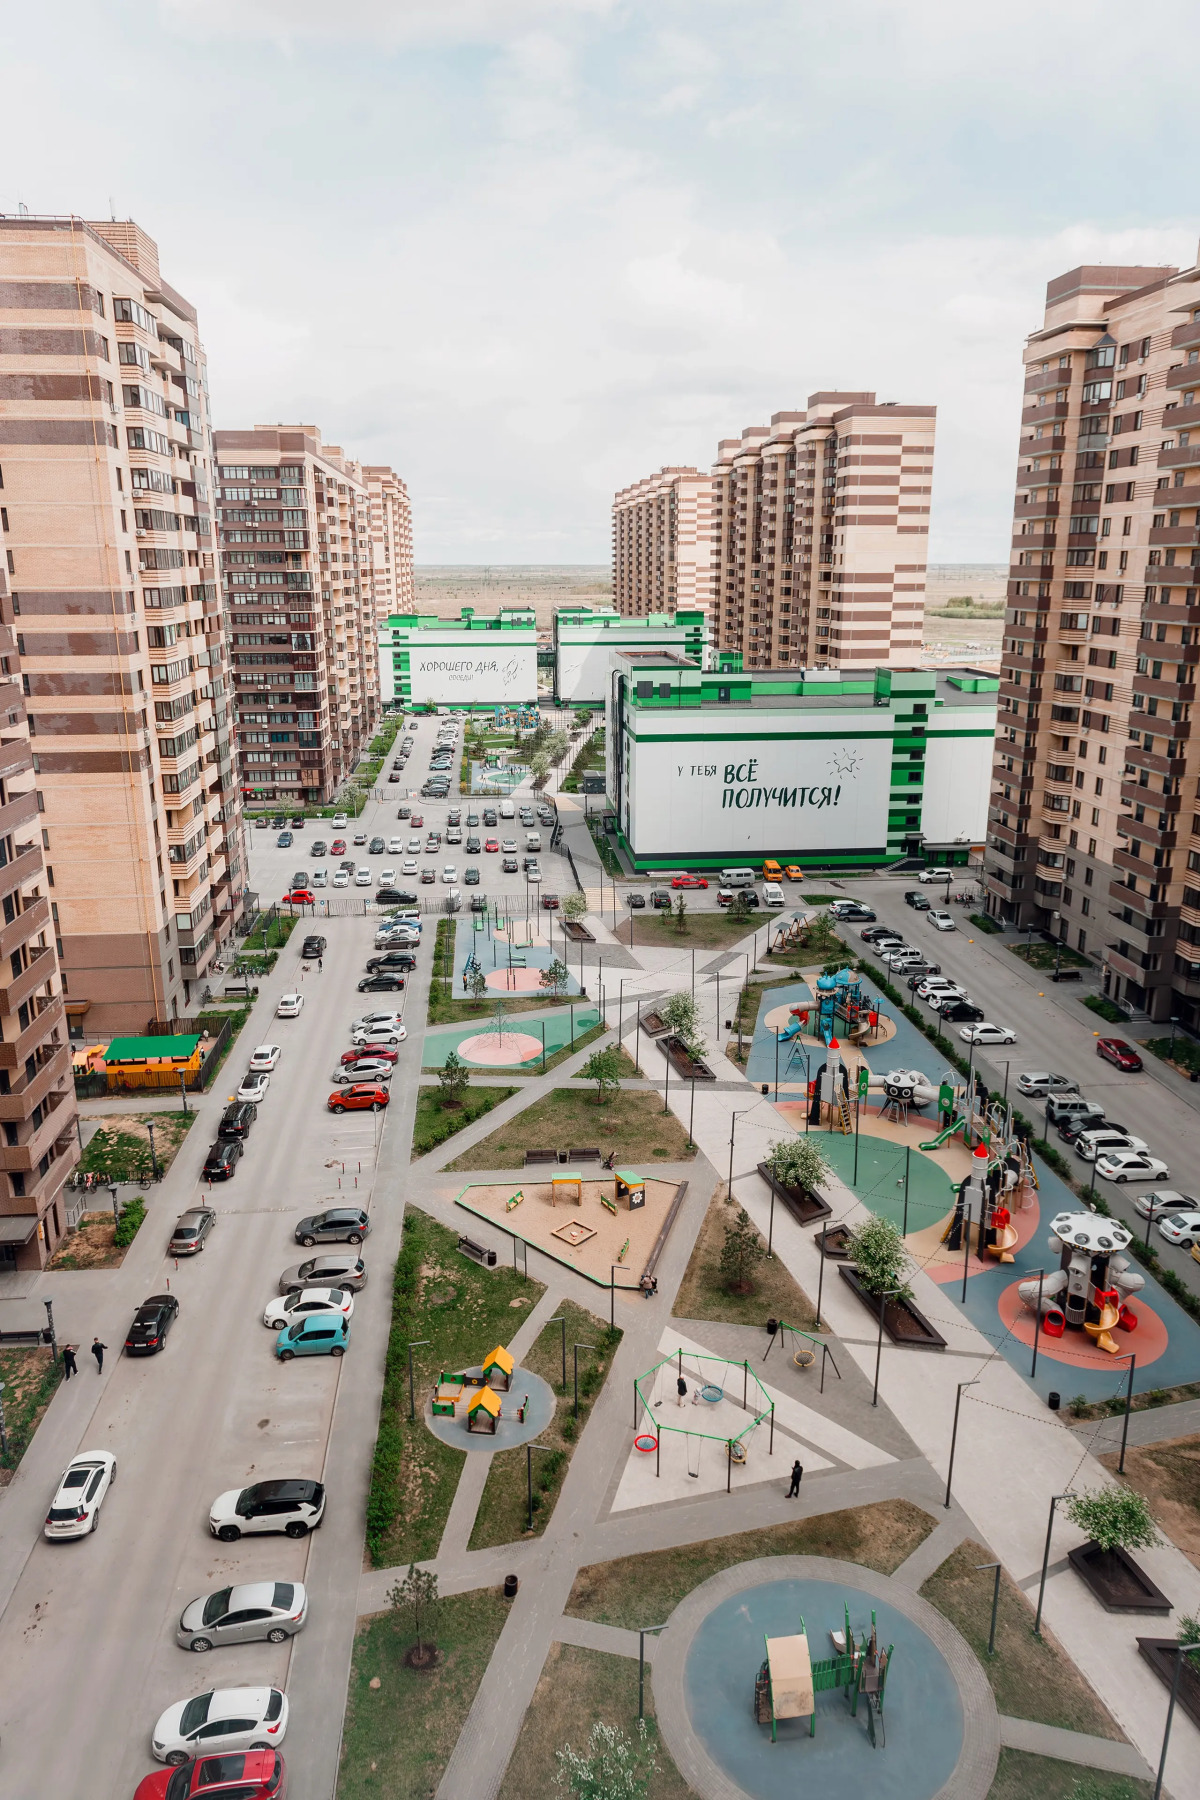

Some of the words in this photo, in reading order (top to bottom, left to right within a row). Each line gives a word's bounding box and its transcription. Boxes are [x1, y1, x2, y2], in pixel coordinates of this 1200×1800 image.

[420, 661, 473, 672] ХОРОШЕГО
[475, 660, 499, 674] ДНЯ,
[677, 765, 684, 777] У
[690, 765, 717, 777] ТЕБЯ
[723, 758, 759, 784] ВСЁ
[721, 784, 842, 809] ПОЛУЧИТСЯ!
